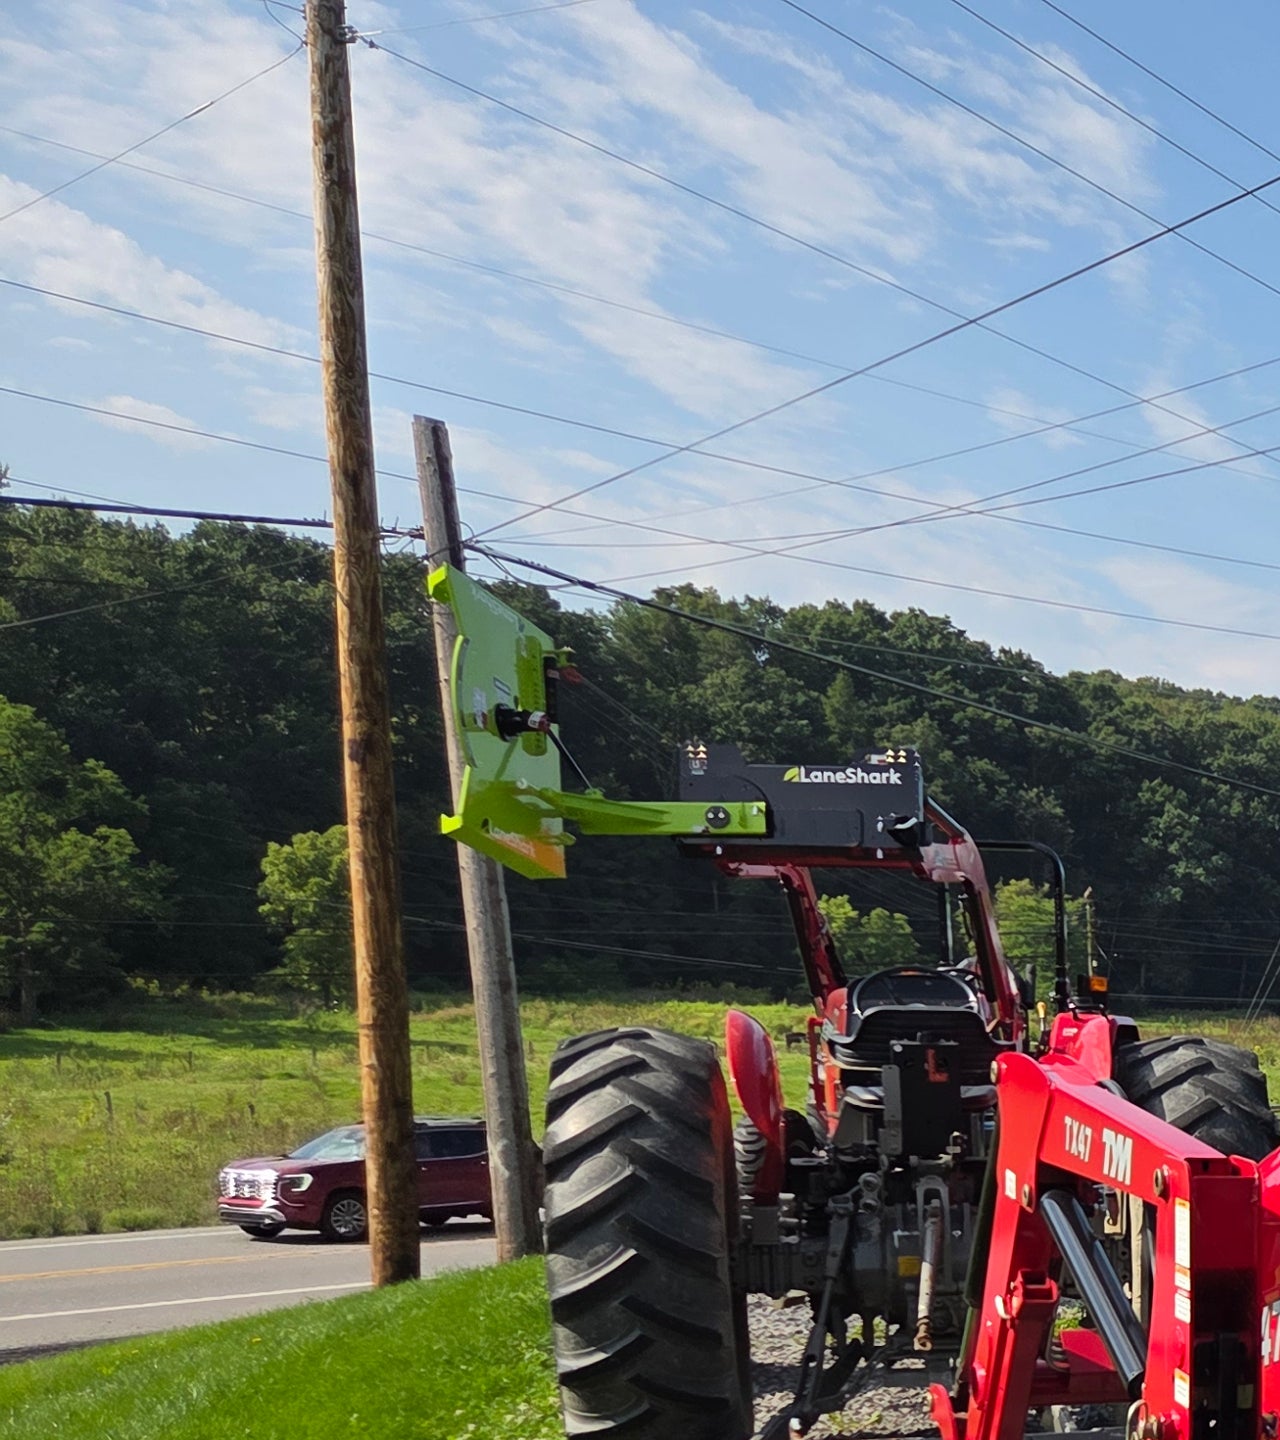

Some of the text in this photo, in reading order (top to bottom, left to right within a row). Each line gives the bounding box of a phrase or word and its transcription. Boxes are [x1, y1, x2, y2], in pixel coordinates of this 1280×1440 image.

[800, 765, 902, 785] LaneShark
[1064, 1115, 1133, 1186] TX47 TYM
